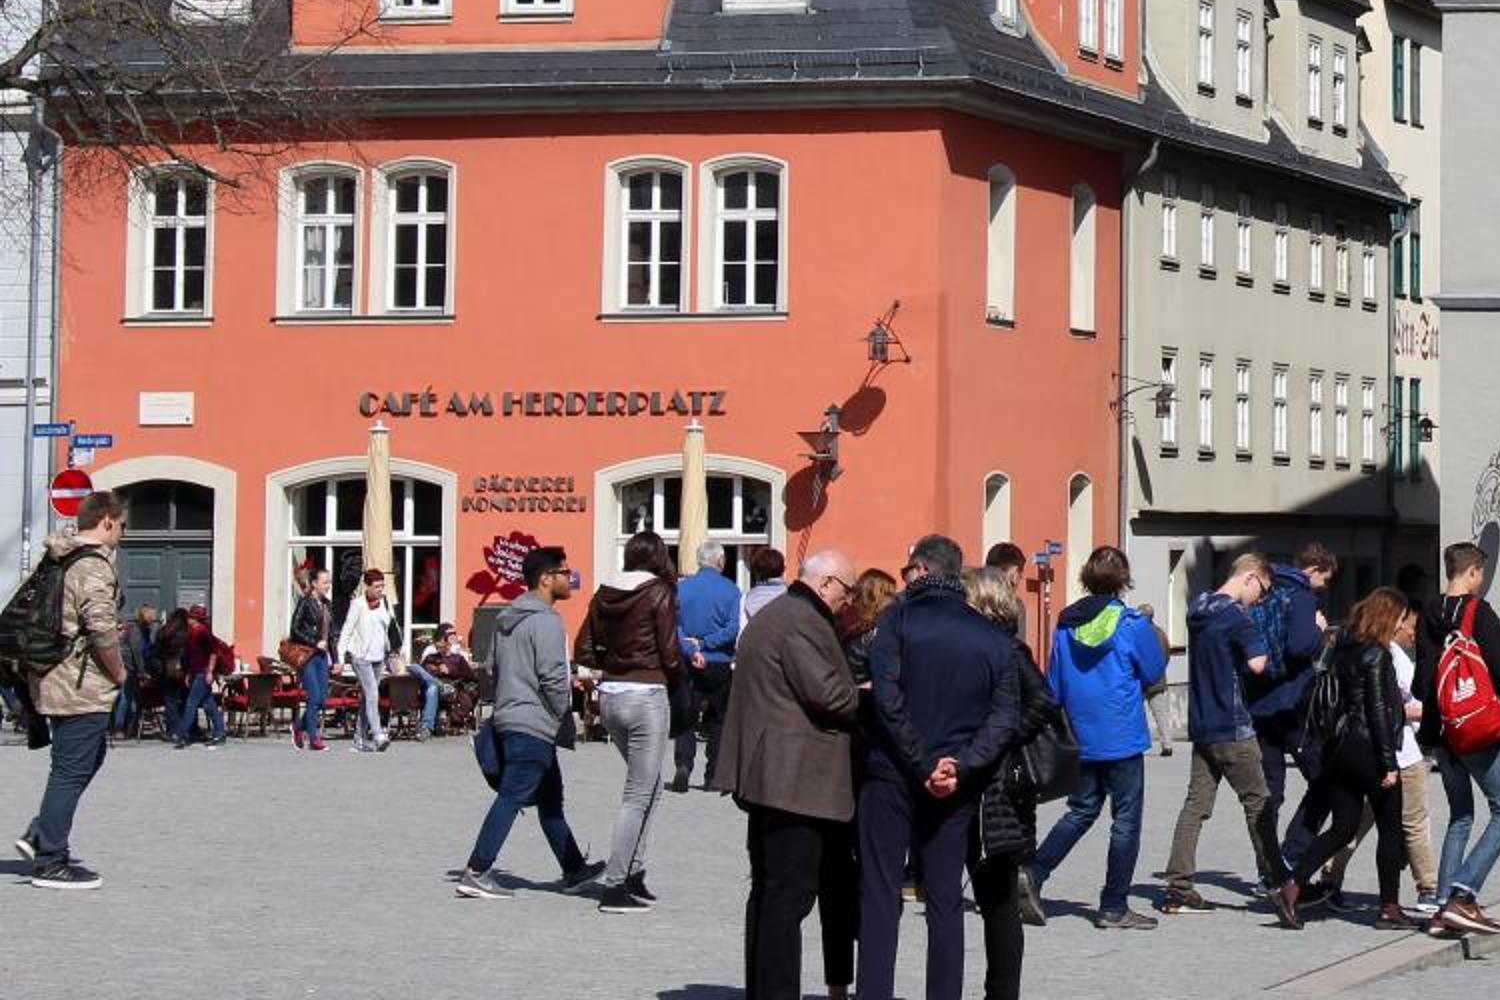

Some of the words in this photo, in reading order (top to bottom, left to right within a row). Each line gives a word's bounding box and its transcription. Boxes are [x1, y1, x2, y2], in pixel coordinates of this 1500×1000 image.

[358, 385, 438, 417] CAFÉ
[445, 391, 494, 417] AM
[502, 387, 728, 418] HERDERPLATZ
[474, 474, 575, 493] BÄCKEREI
[461, 495, 587, 513] KONDITOREI
